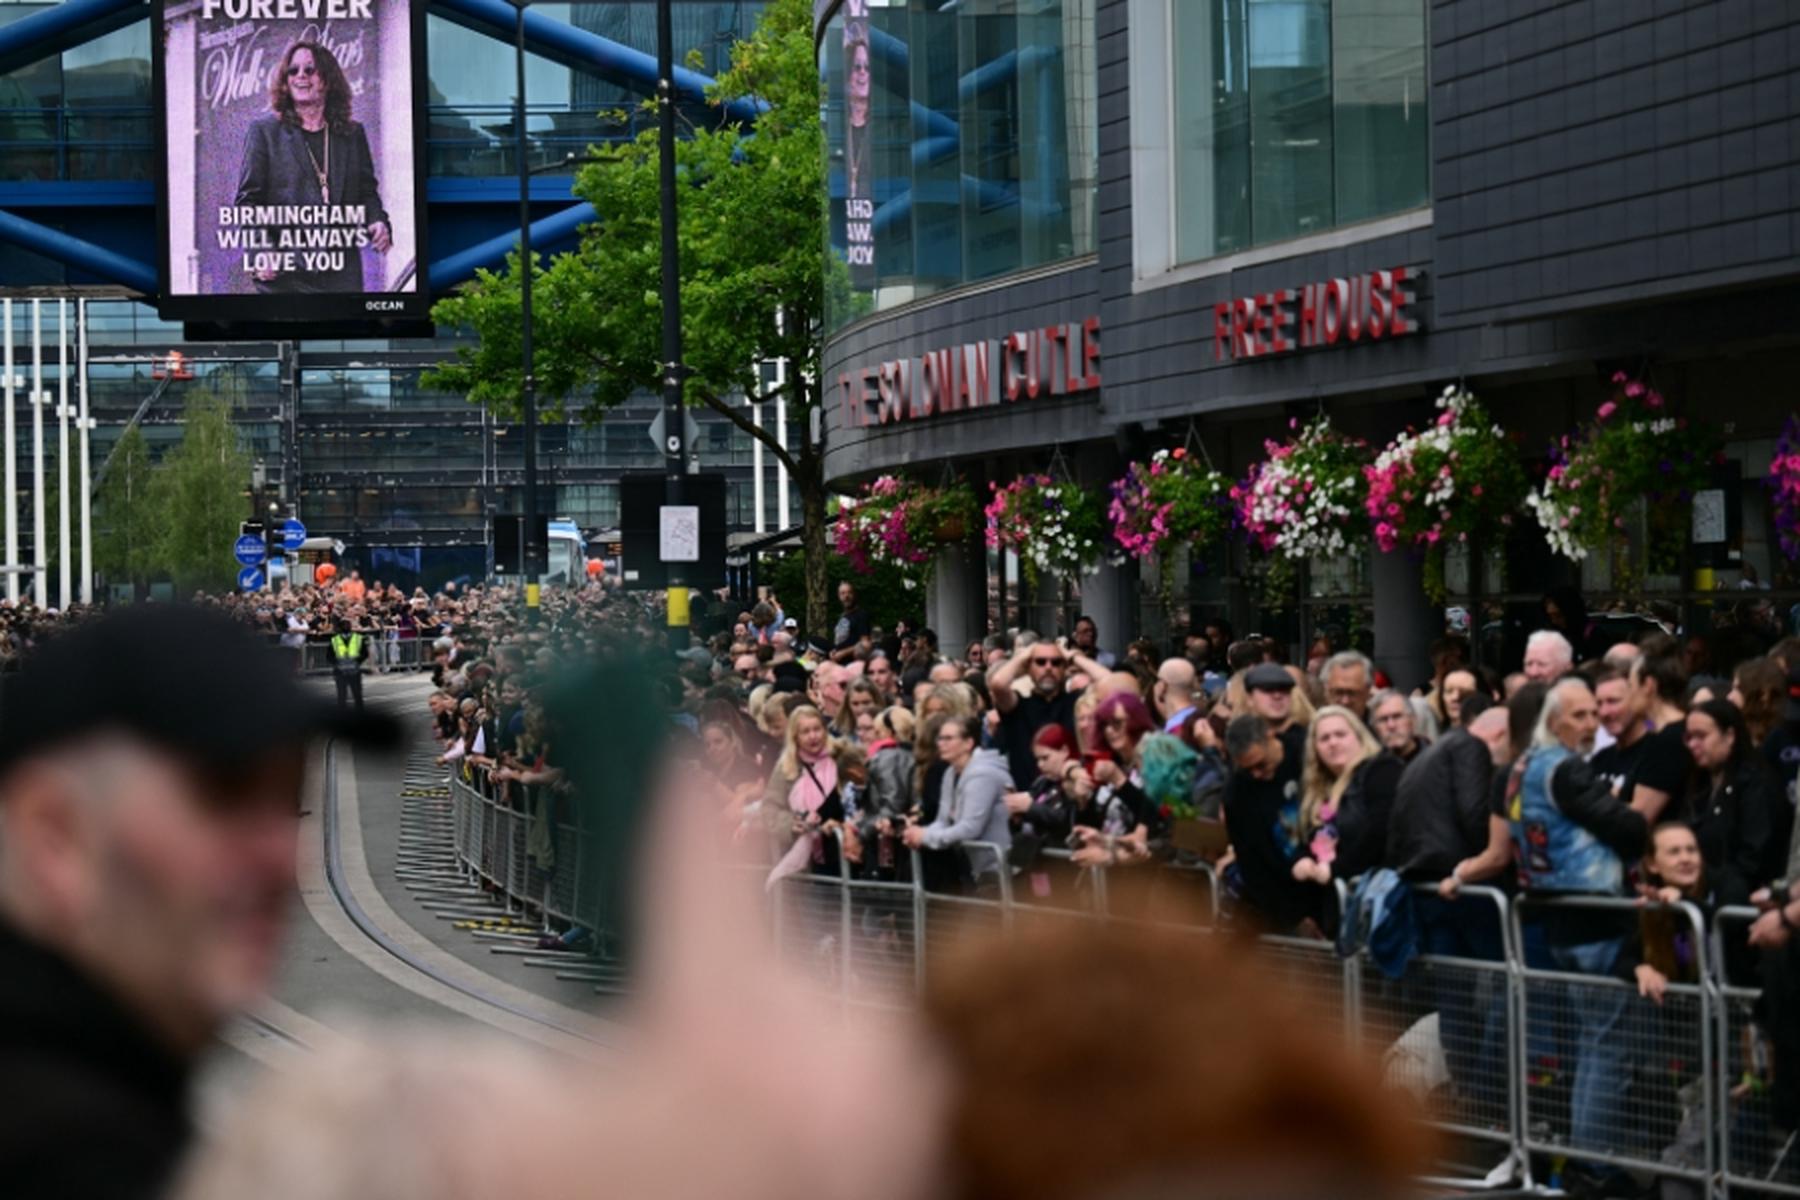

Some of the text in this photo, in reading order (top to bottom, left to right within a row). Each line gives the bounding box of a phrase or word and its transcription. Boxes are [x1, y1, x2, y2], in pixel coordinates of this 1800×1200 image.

[202, 0, 373, 19] FOREVER
[218, 205, 366, 226] BIRMINGHAM
[217, 228, 369, 249] WILL ALWAYS
[243, 251, 344, 272] LOVE YOU
[366, 301, 404, 312] OCEAN
[1214, 265, 1418, 362] FREE HOUSE
